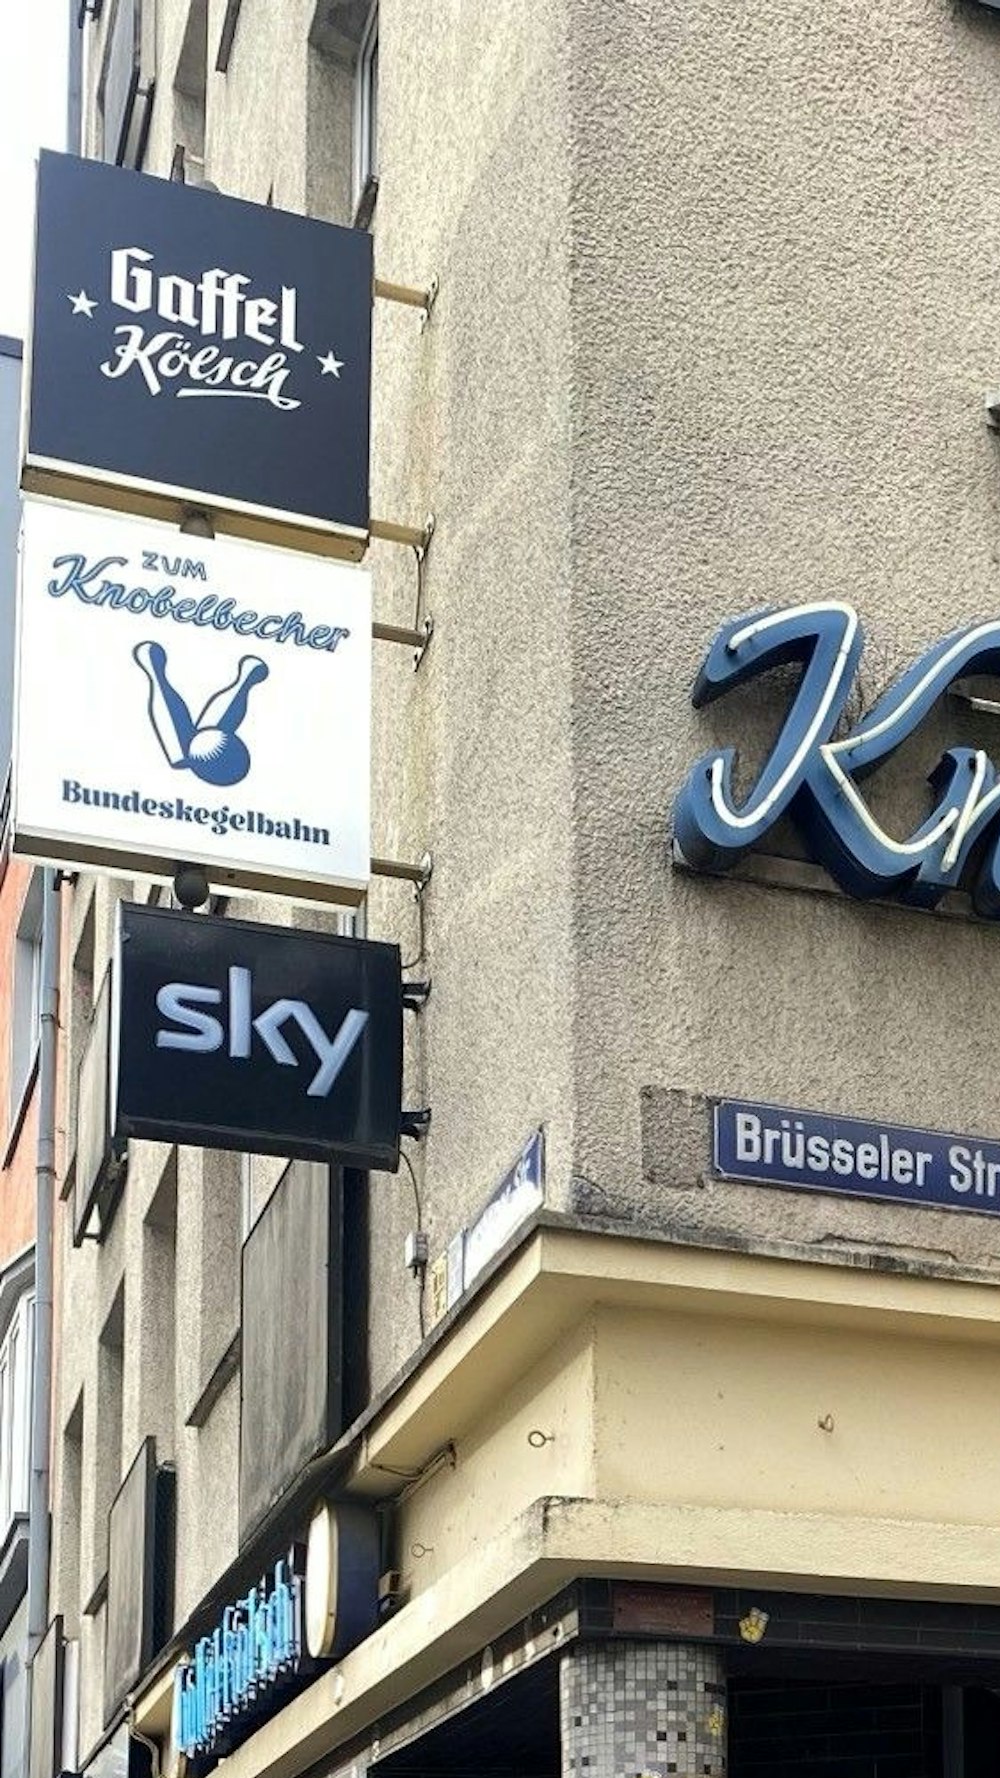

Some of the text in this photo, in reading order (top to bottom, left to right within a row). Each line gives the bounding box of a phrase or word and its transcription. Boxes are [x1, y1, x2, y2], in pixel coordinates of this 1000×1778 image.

[110, 247, 304, 352] Gaffel
[101, 325, 302, 410] Kölsch
[48, 553, 350, 653] Knobelbecher
[142, 551, 207, 581] ZUM
[61, 779, 331, 846] Bundeskegelbahn
[156, 966, 368, 1097] sky
[734, 1111, 932, 1187] Brüsseler
